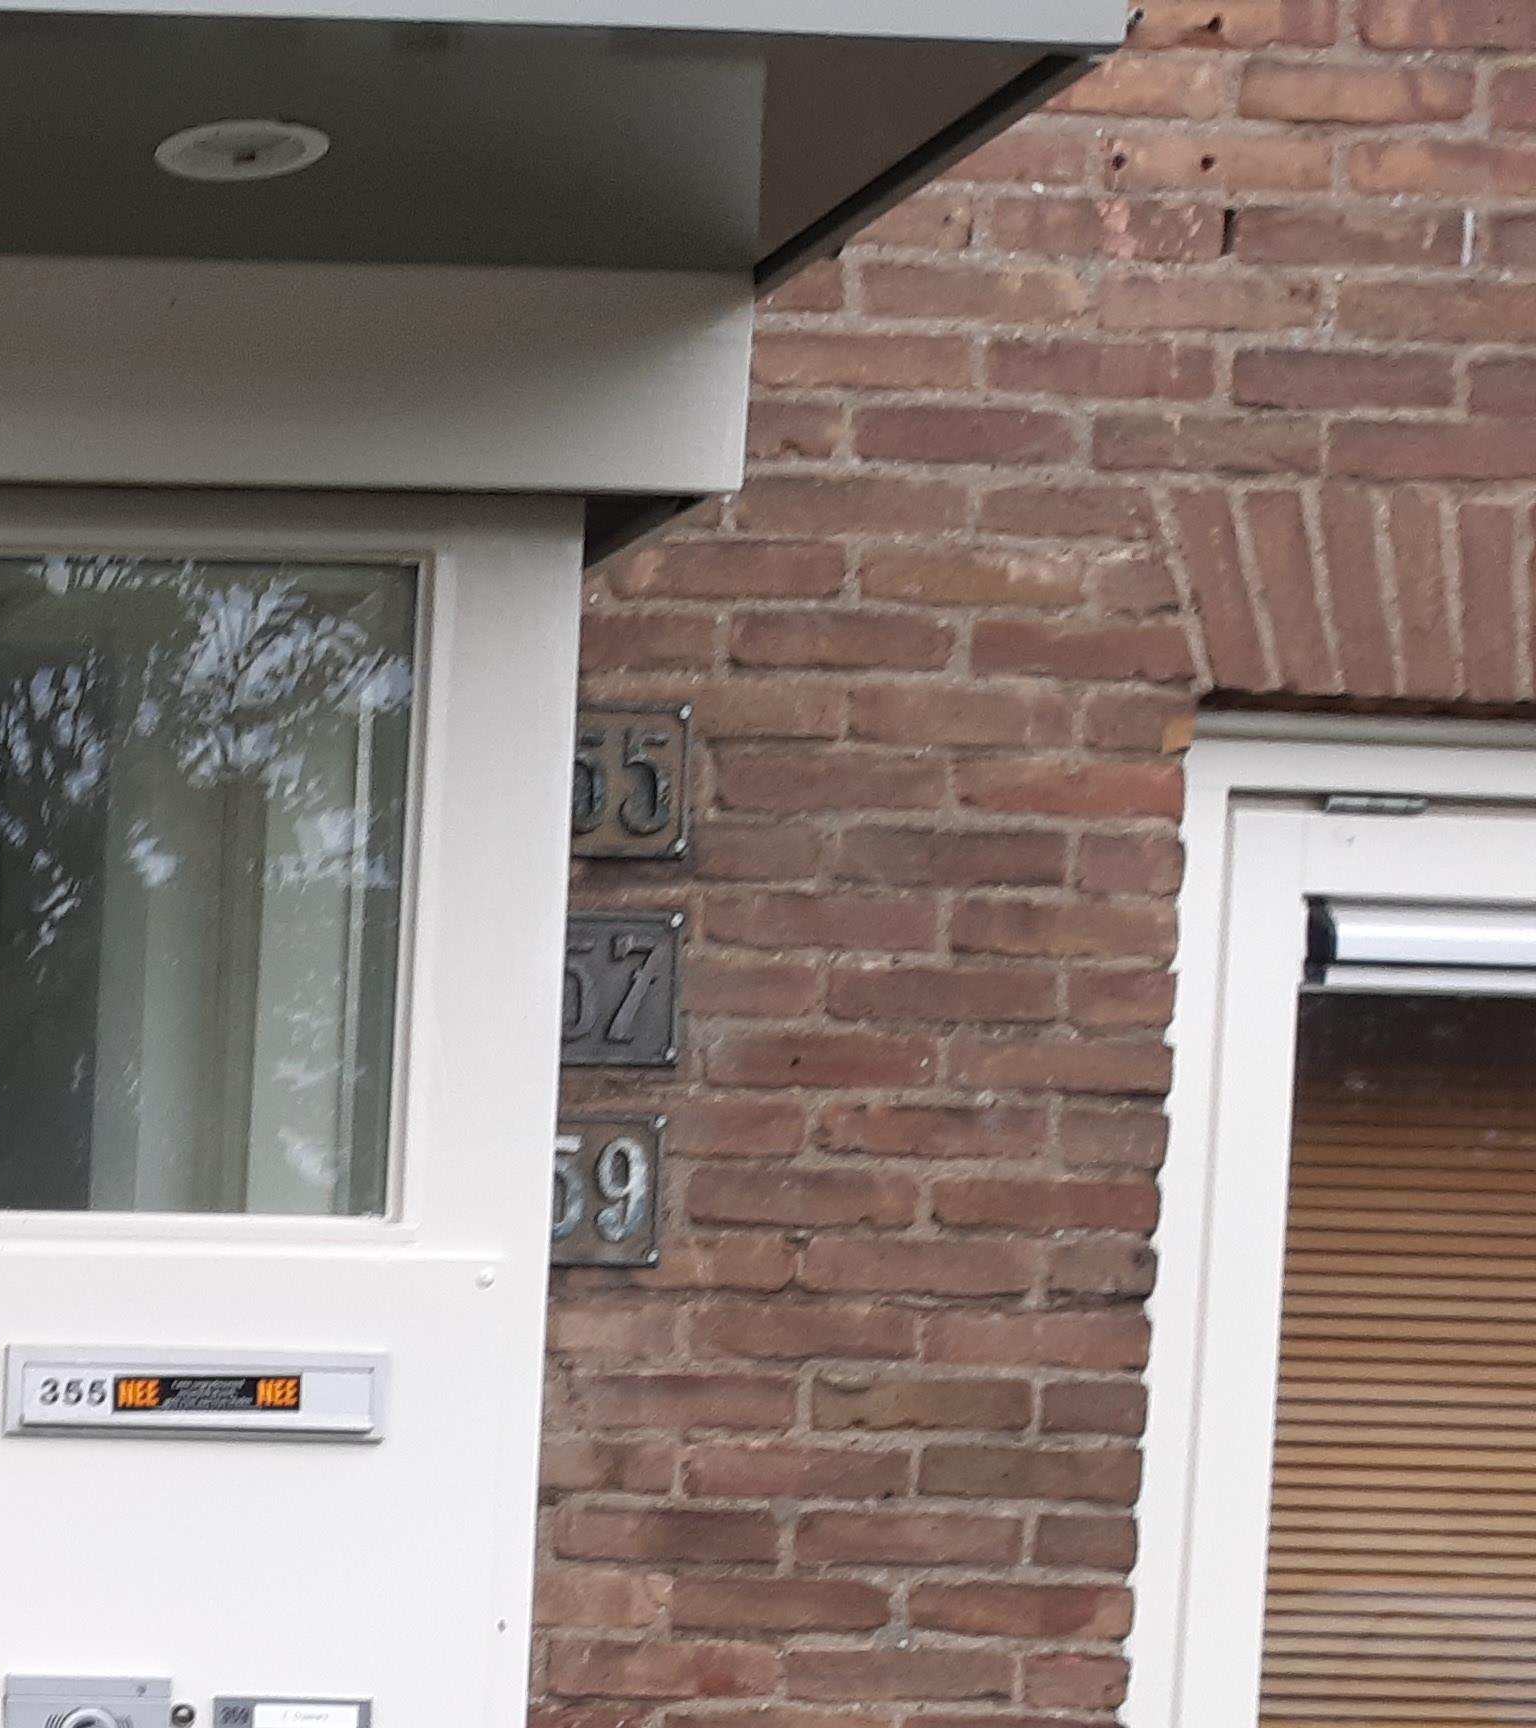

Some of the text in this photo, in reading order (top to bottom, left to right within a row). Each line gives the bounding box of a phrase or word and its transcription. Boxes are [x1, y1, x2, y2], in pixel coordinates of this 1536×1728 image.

[39, 1377, 108, 1407] 355
[117, 1378, 162, 1408] NEE
[255, 1378, 301, 1408] NEE
